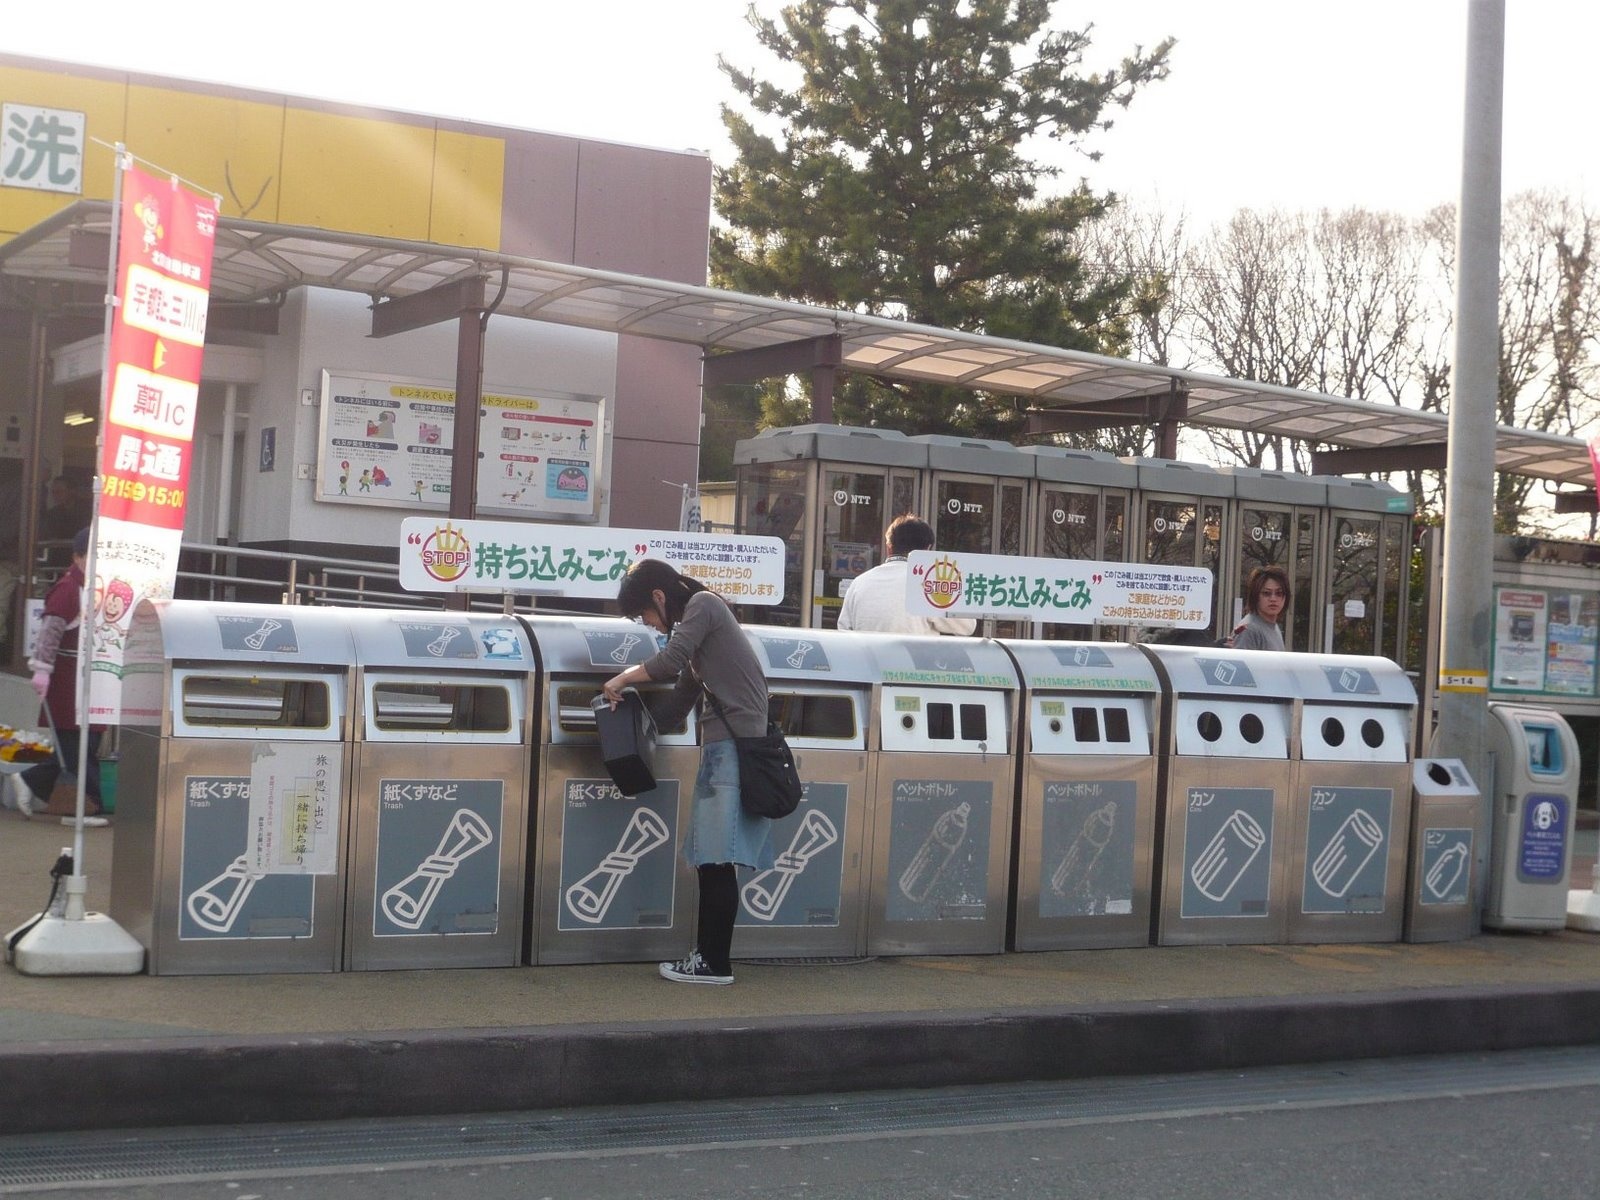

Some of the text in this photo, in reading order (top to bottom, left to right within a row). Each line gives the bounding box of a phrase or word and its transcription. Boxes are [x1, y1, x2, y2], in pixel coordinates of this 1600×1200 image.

[4, 112, 79, 186] 洗
[850, 494, 871, 505] NTT
[963, 503, 983, 513] NTT
[1067, 513, 1087, 524] NTT
[422, 550, 472, 568] STOP!
[700, 580, 779, 597] みはお断りします。
[923, 573, 1092, 610] STOP! 持ち込みごみ
[384, 784, 458, 801] 紙くずなど
[568, 783, 637, 800] 紙くずな
[897, 782, 956, 797] ペットボトル
[1047, 783, 1103, 798] ペットボトル
[1313, 790, 1337, 805] カン
[1190, 791, 1215, 807] カン
